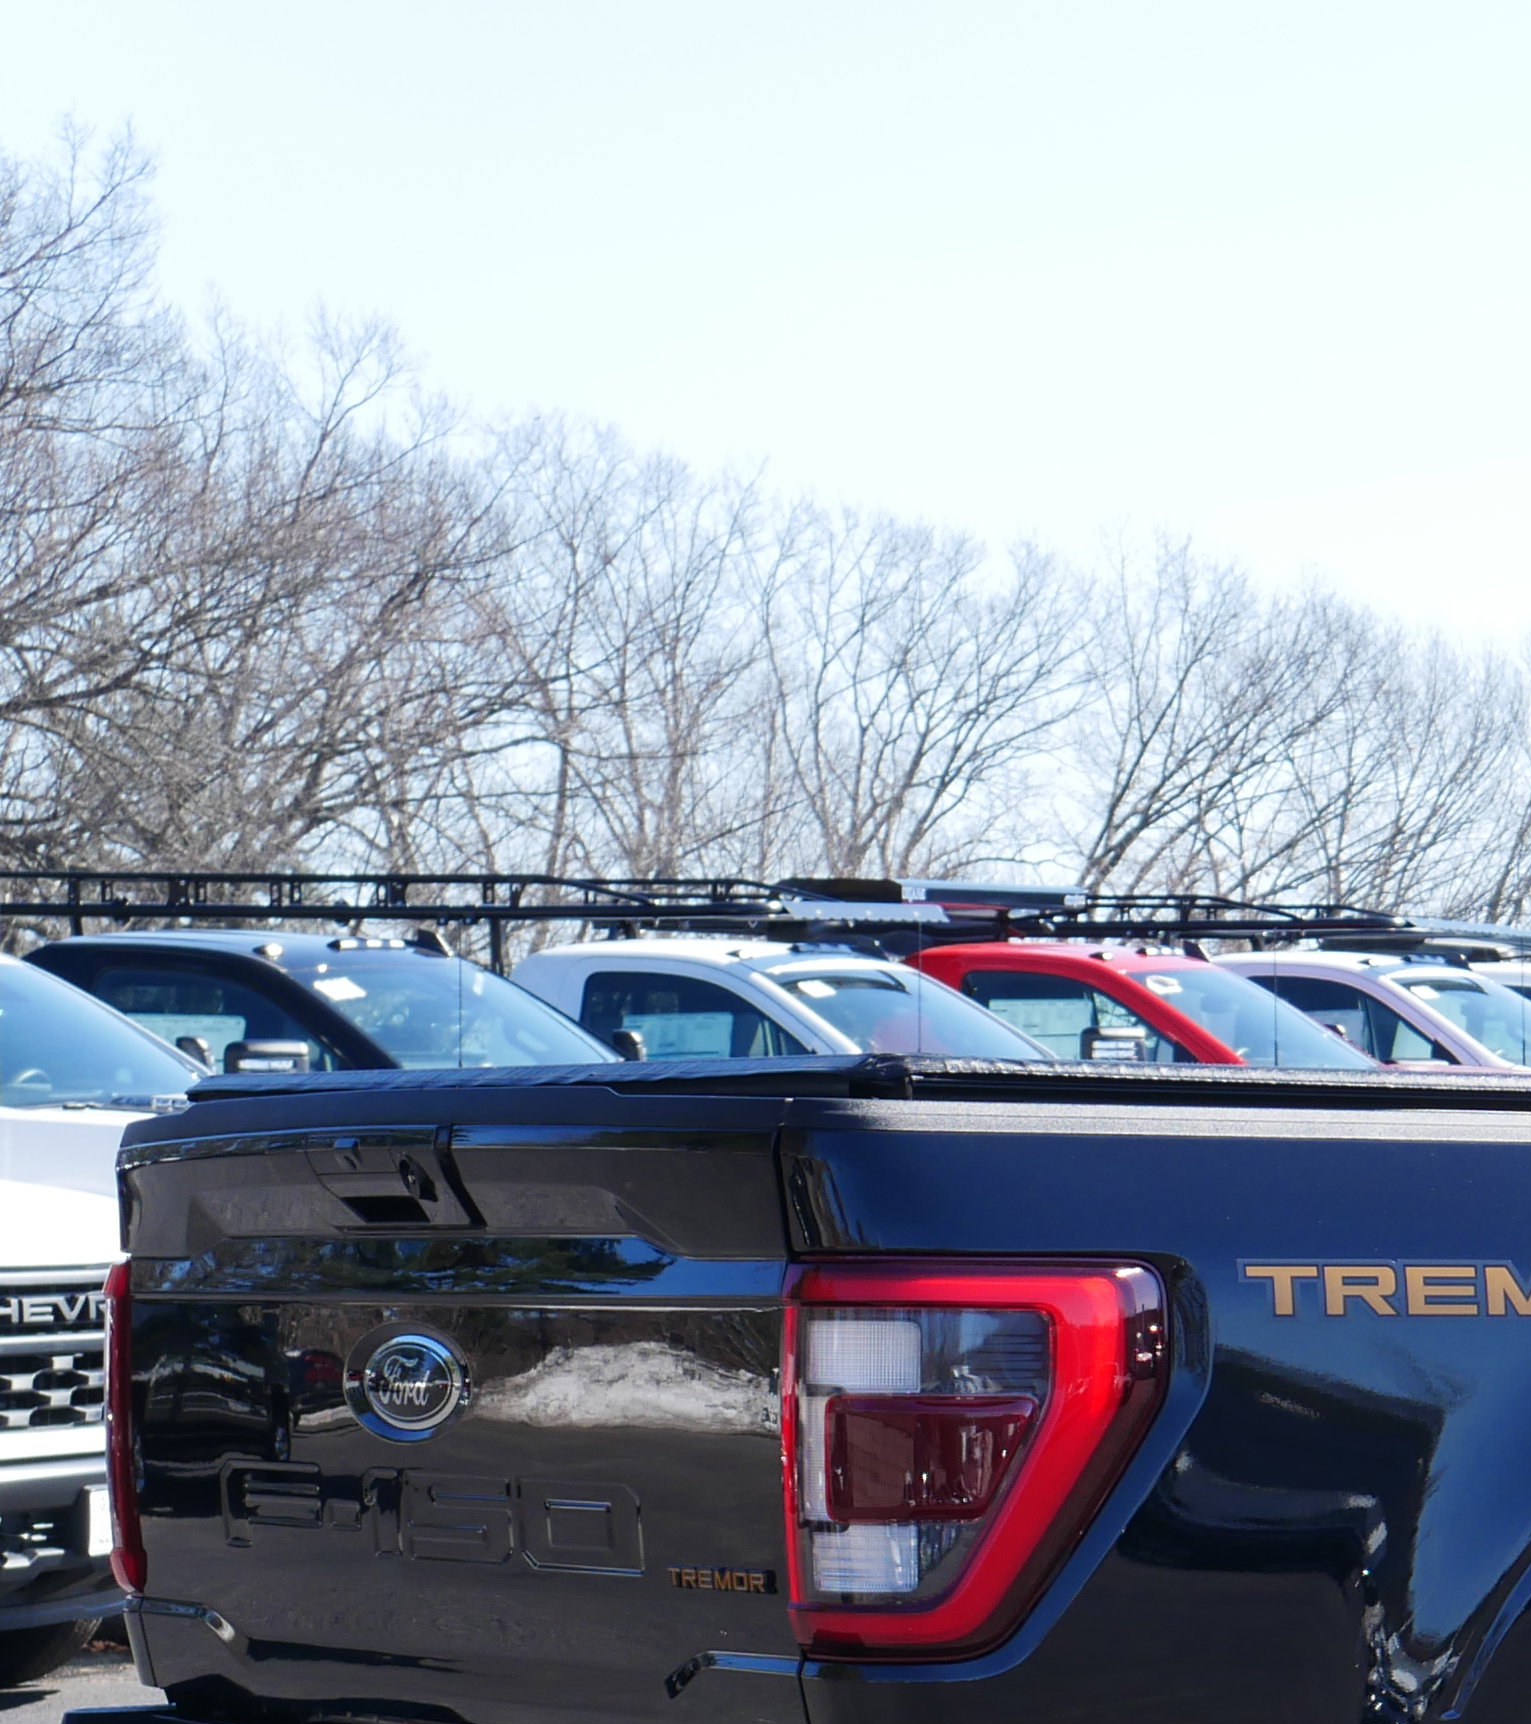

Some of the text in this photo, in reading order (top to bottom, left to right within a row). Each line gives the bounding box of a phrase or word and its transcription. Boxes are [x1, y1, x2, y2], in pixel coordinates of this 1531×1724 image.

[380, 1354, 431, 1406] Ford
[219, 1459, 645, 1577] F-150
[666, 1564, 773, 1594] TREMOR
